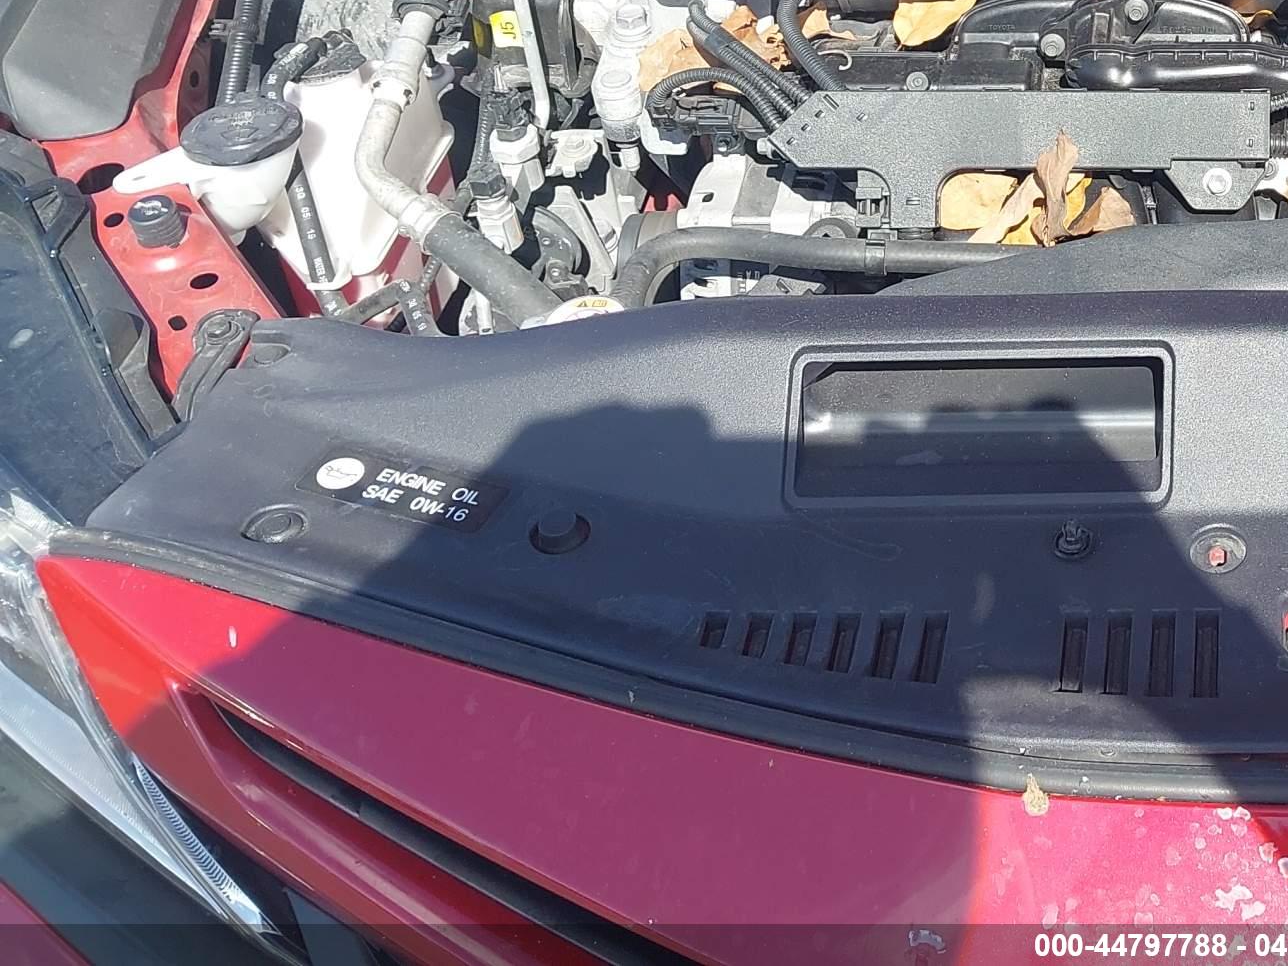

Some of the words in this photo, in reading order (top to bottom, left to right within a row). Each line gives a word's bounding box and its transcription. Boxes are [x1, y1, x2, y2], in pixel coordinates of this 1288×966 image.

[362, 484, 404, 504] SAE
[409, 496, 469, 522] 0W-16
[375, 468, 447, 496] ENGINE
[451, 487, 479, 505] OIL
